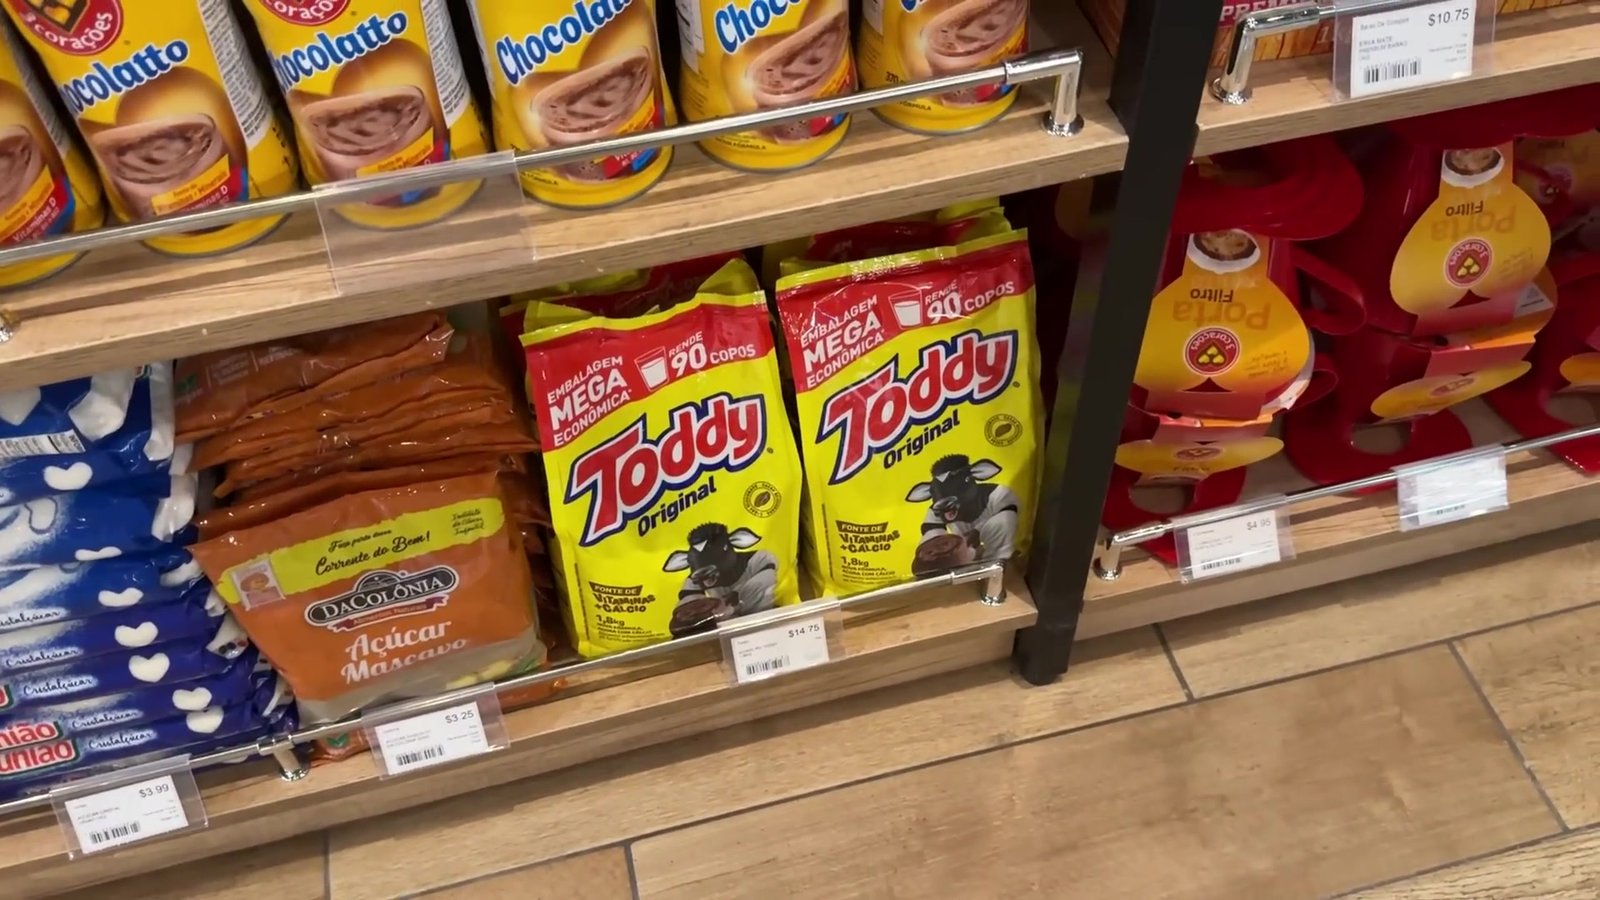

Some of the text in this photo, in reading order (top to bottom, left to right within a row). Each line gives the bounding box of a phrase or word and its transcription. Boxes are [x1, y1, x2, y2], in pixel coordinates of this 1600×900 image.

[496, 0, 632, 85] Chocola
[715, 0, 800, 53] Choc
[266, 11, 408, 97] hocolatto
[60, 40, 188, 114] ocolatto
[1431, 204, 1516, 242] Porta
[1446, 199, 1483, 217] Filtro
[927, 281, 1015, 324] 90 COPOS
[1172, 301, 1271, 331] Porta
[1190, 288, 1234, 303] Filtro
[801, 294, 878, 348] EMBALAGEM
[803, 311, 882, 373] MEGA
[668, 331, 703, 357] RENDE
[671, 343, 756, 377] 90 COPOS
[547, 356, 623, 404] EMBALAGEM
[550, 369, 628, 430] MEGA
[817, 331, 1017, 483] Toddy
[883, 409, 961, 470] Original
[565, 393, 766, 545] Toddy
[638, 475, 717, 537] Original
[839, 530, 900, 544] VITAMINAS
[841, 524, 869, 532] FONTE
[315, 549, 370, 576] Corrente
[391, 530, 430, 553] Bem!
[841, 556, 869, 567] 1,8kg
[593, 592, 656, 605] VITAMINAS
[594, 585, 624, 594] FONTE
[345, 621, 452, 662] Açúcar
[596, 614, 625, 626] 1,8kg
[340, 638, 468, 685] Mascavo
[0, 721, 56, 748] nião
